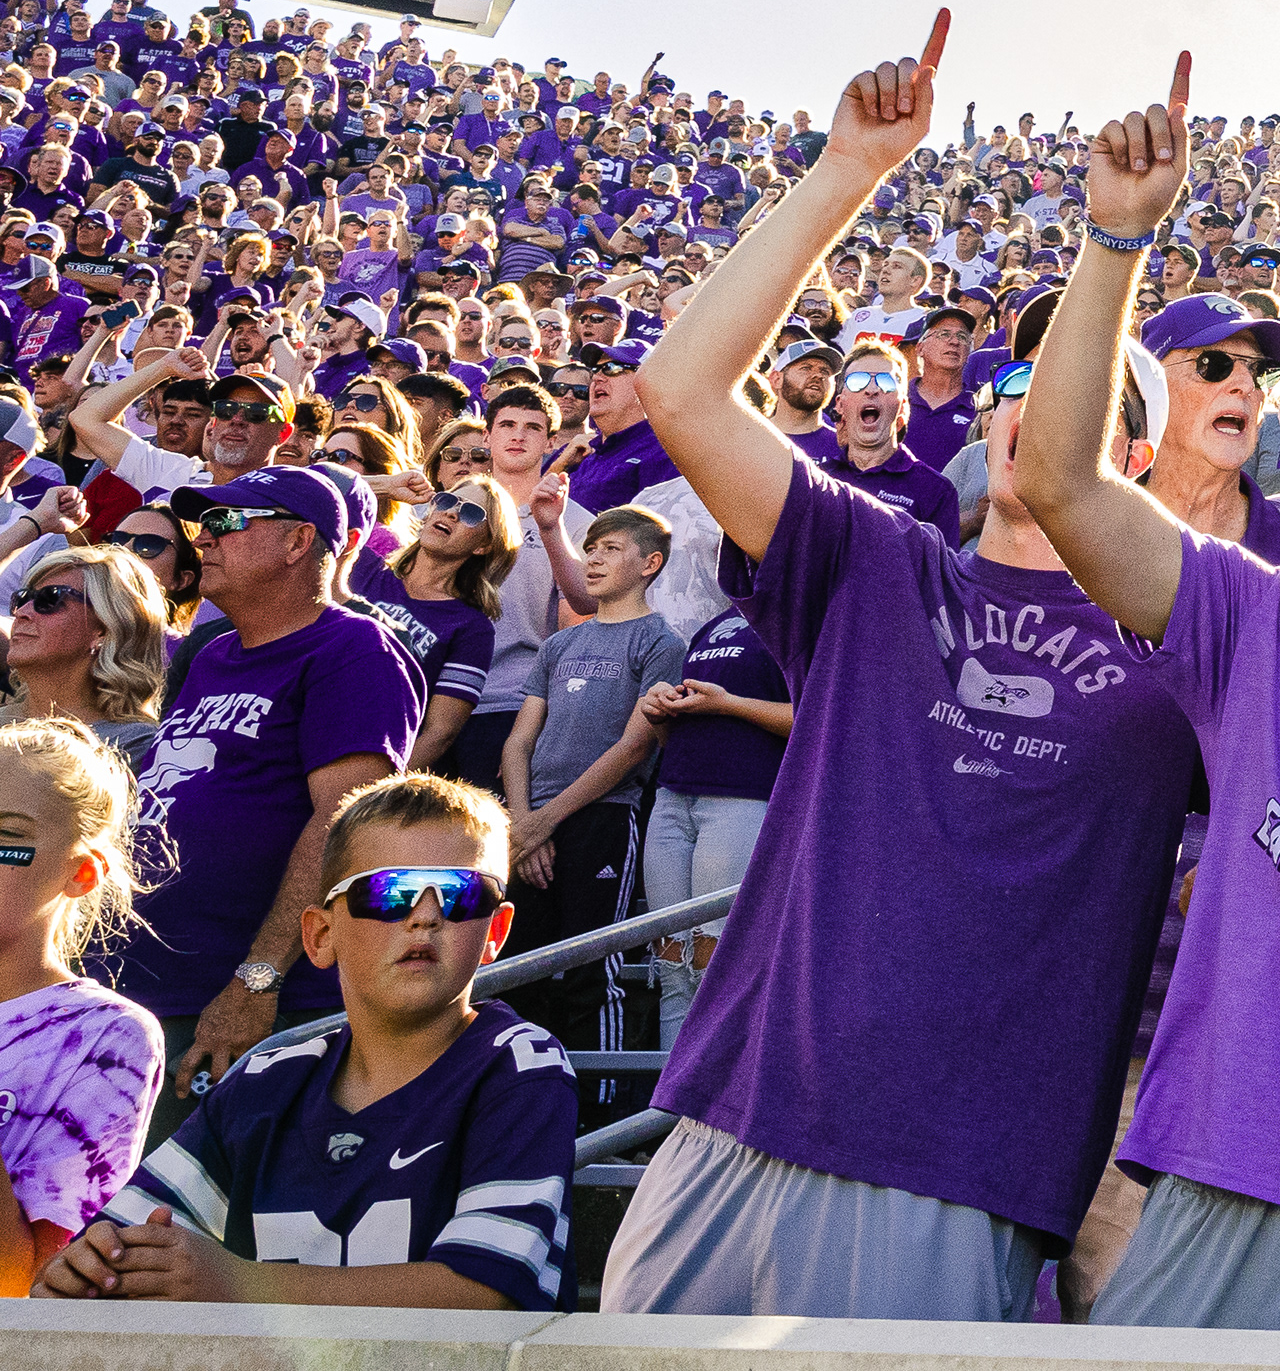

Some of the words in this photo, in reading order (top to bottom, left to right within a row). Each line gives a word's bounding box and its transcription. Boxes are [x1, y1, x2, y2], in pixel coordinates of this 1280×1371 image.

[599, 158, 624, 184] 21
[1034, 208, 1059, 220] K-STA
[689, 646, 744, 662] K-STATE
[1013, 736, 1068, 765] DEPT.
